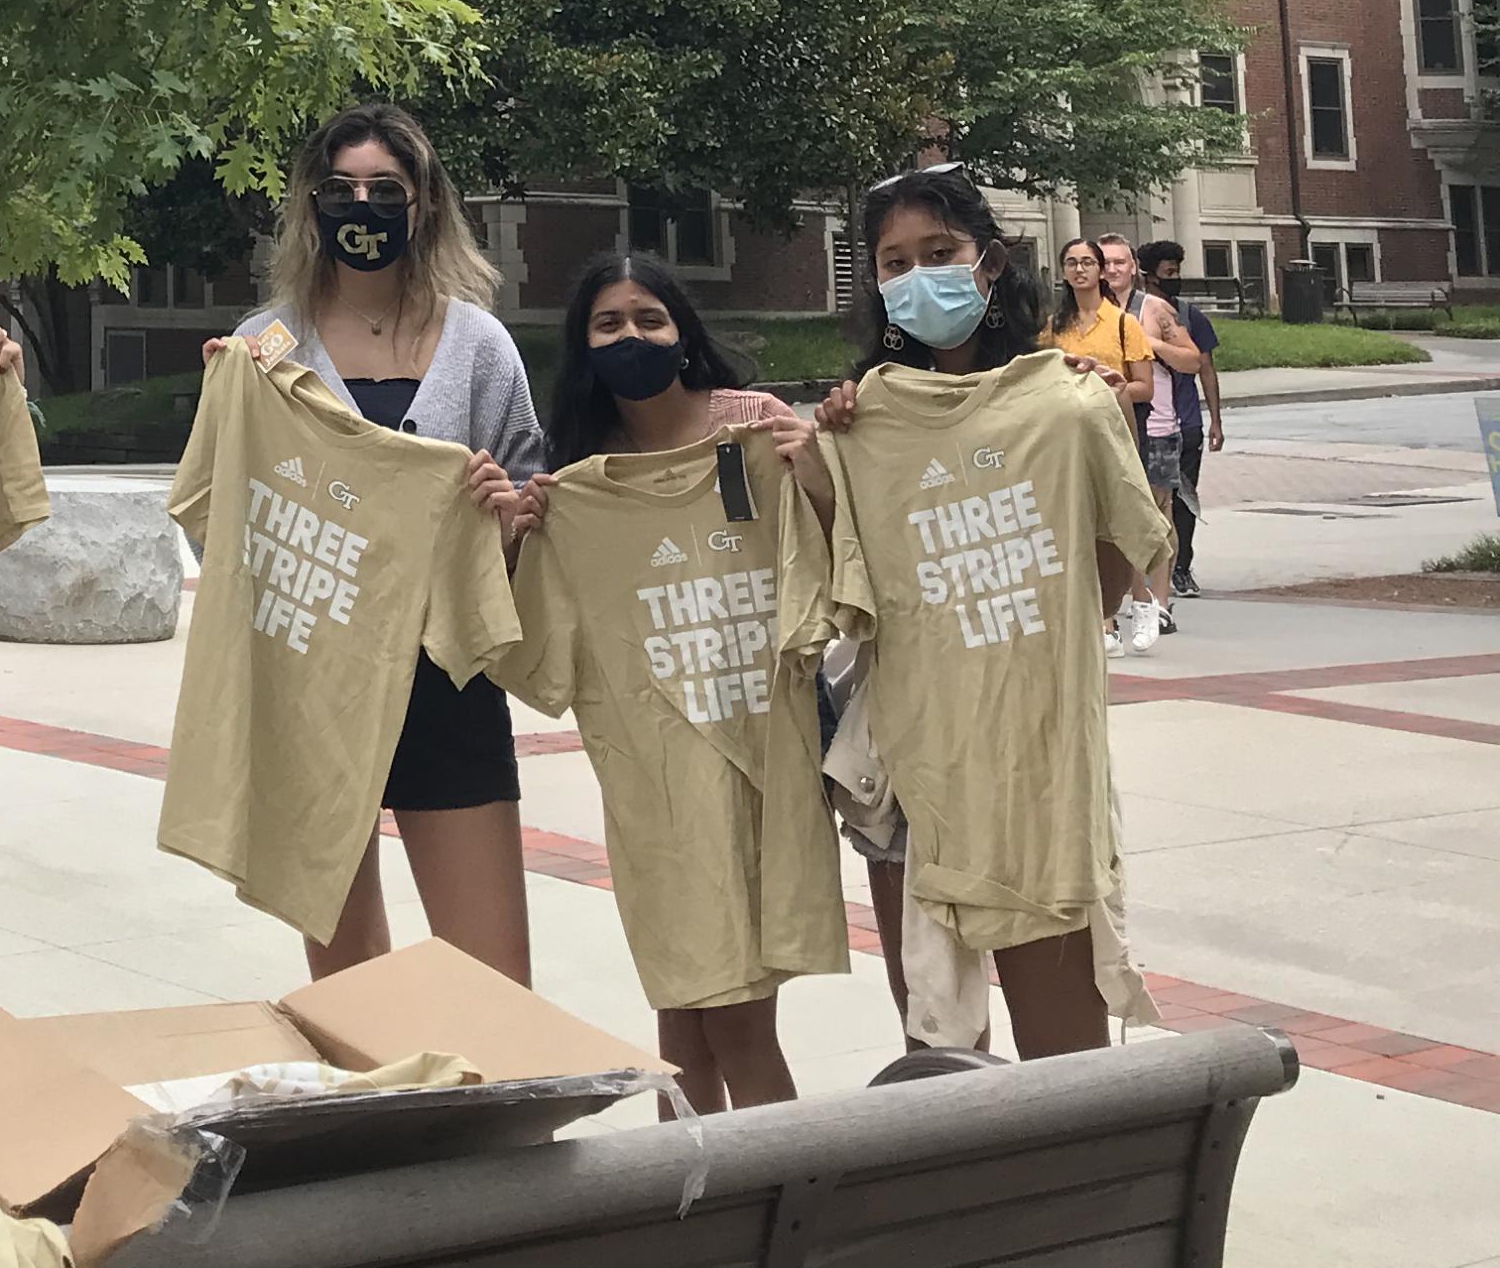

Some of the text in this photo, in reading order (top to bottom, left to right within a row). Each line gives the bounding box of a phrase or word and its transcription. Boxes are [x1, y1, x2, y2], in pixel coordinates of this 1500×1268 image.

[337, 223, 387, 261] GT
[973, 446, 1004, 469] GT
[328, 480, 360, 510] GT
[908, 480, 1042, 554] THREE
[248, 477, 369, 578] THREE
[651, 529, 743, 567] adidas GT
[916, 528, 1064, 605] STRIPE
[253, 589, 318, 654] IFE
[636, 568, 778, 630] THREE
[955, 587, 1046, 649] LIFE
[683, 669, 771, 724] LIFE
